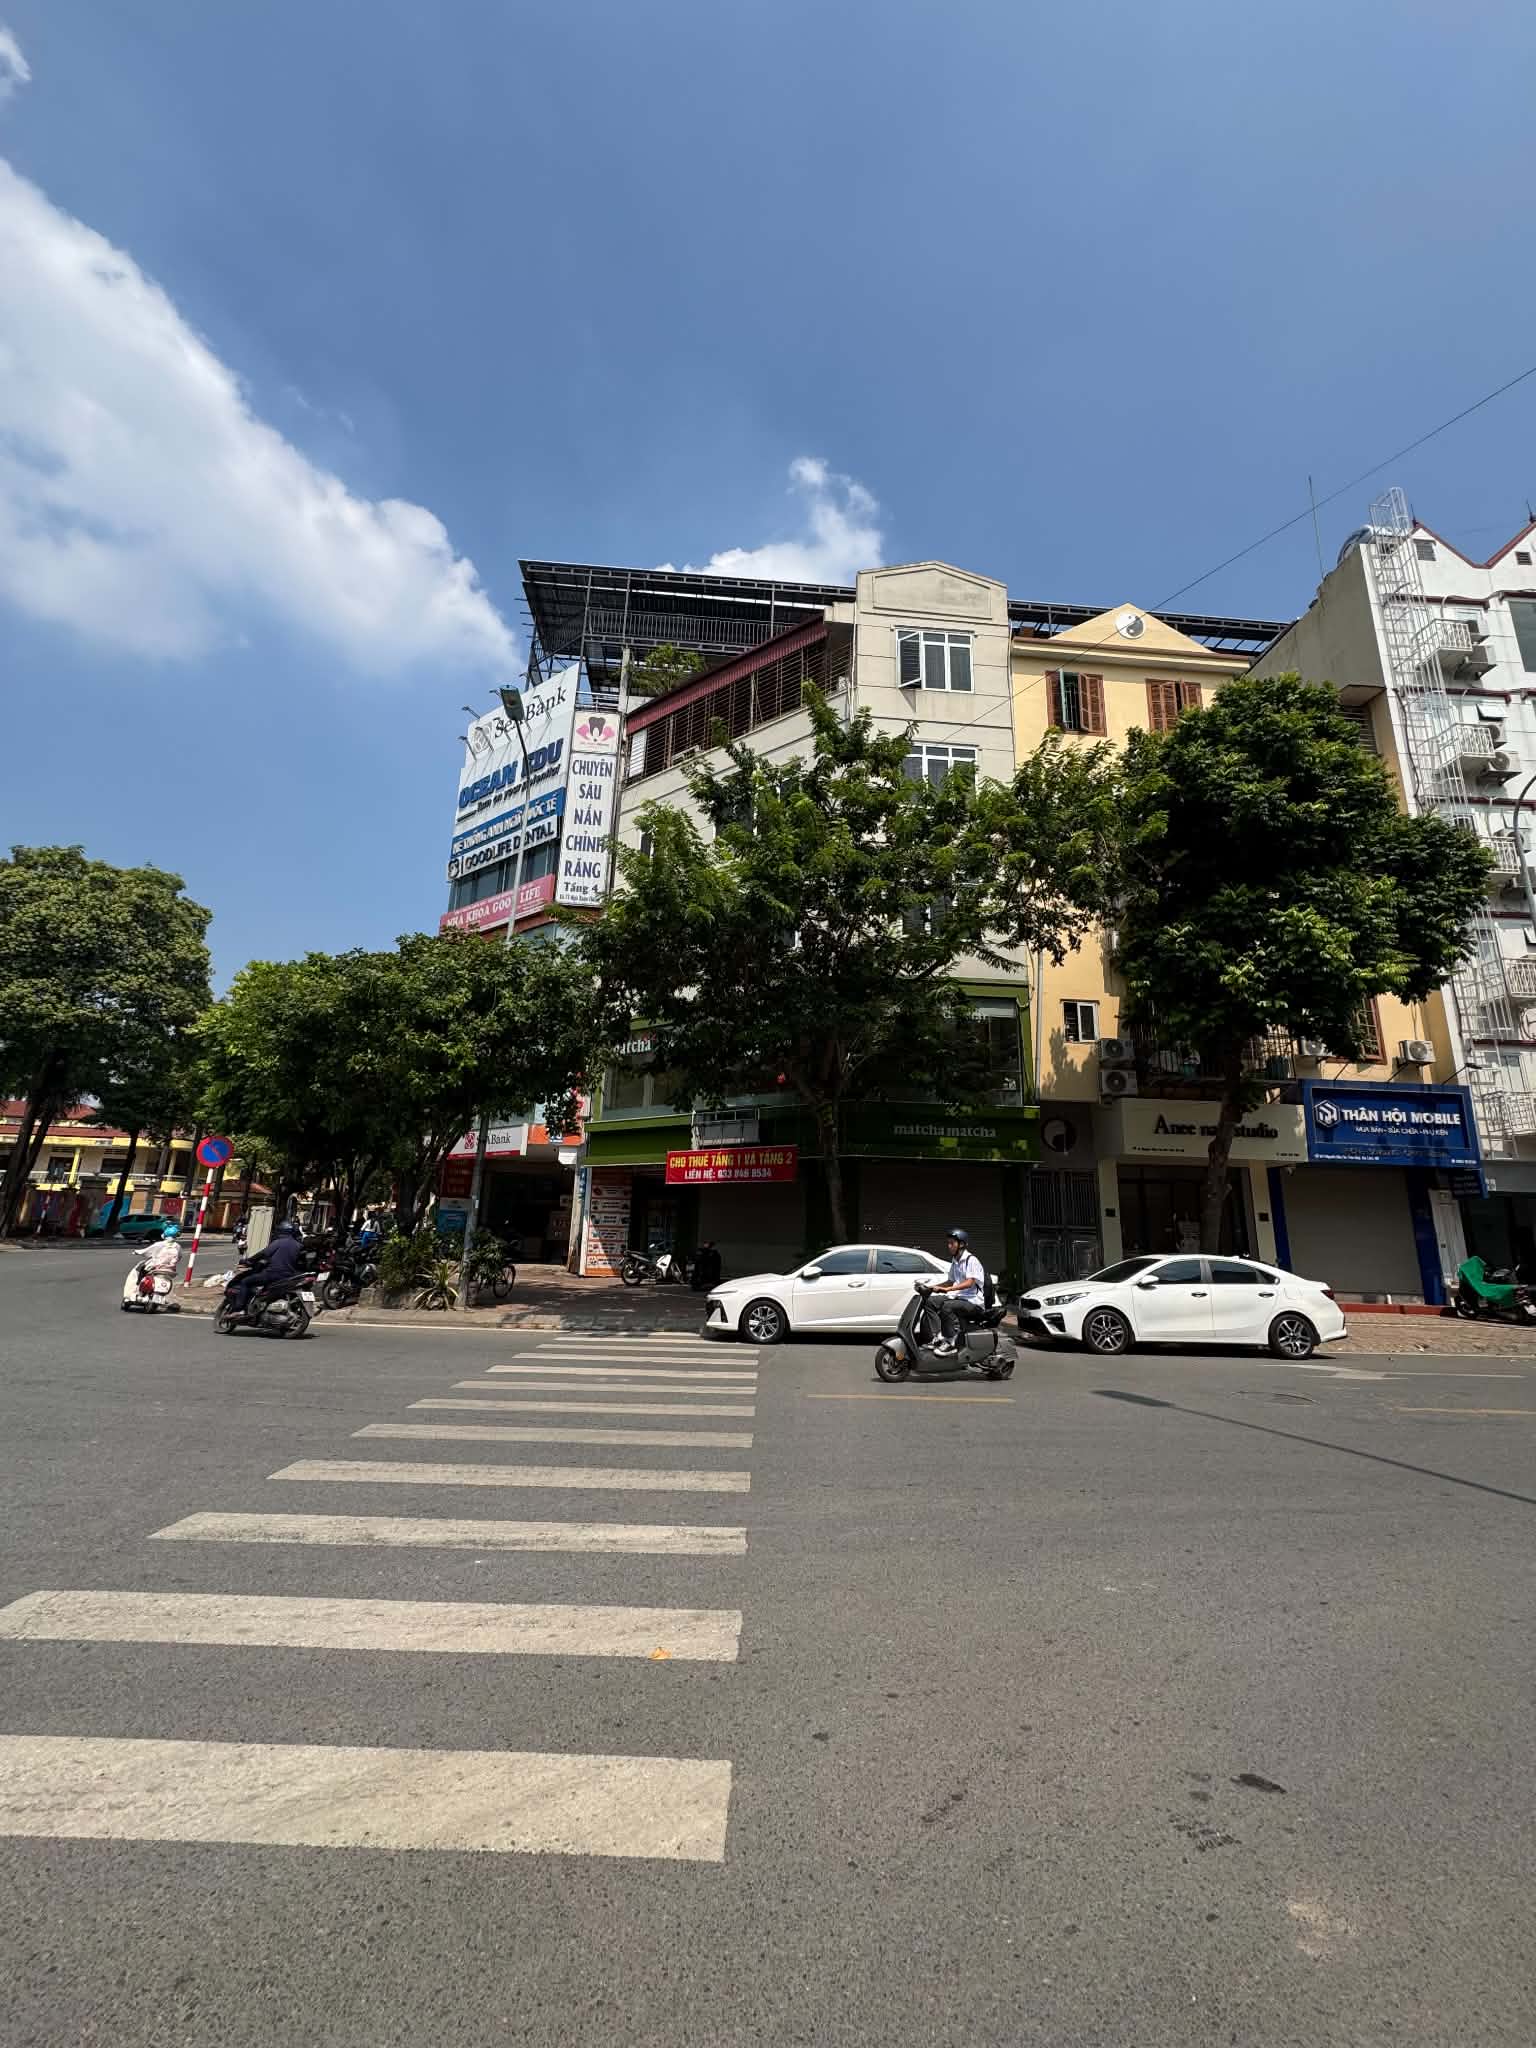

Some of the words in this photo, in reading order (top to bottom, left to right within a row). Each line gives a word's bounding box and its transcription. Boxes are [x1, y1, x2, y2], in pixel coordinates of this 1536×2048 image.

[572, 759, 613, 777] CHUYÊN
[579, 781, 602, 800] SÂU
[513, 821, 555, 850] DNTAL
[564, 858, 602, 879] RĂNG
[591, 884, 600, 894] 4
[465, 904, 491, 923] KHOA
[493, 897, 514, 913] GOO
[519, 886, 542, 904] LIFE
[1341, 1107, 1378, 1122] THÂN
[1382, 1108, 1407, 1126] HỘI
[1411, 1112, 1462, 1125] MOBILE
[893, 1124, 945, 1136] matcha
[946, 1126, 997, 1137] matcha
[1232, 1121, 1279, 1139] studio
[670, 1156, 687, 1169] CHO
[688, 1153, 709, 1168] THUÊ
[785, 1152, 793, 1164] 2
[684, 1168, 701, 1180] LIÊN
